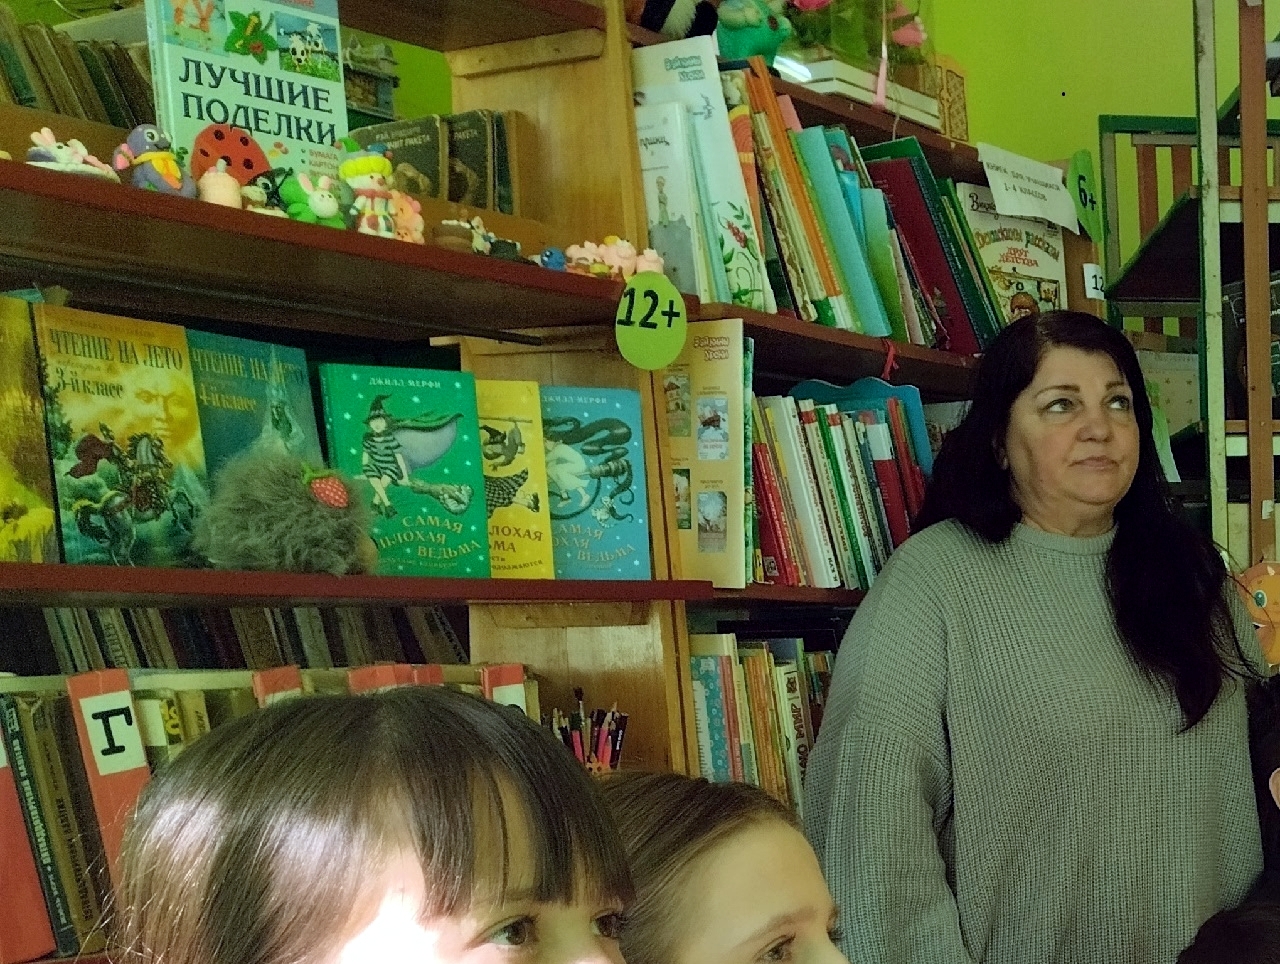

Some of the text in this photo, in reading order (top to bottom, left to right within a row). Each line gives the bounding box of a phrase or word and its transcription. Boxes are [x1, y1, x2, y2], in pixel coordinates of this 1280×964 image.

[178, 57, 333, 114] ЛУЧШИЕ
[181, 91, 336, 147] ПОДЕЛКИ
[1077, 174, 1097, 211] 6+
[616, 286, 681, 330] 12+
[50, 328, 114, 362] ЧТЕНИЕ
[118, 340, 139, 365] НА
[142, 343, 183, 370] ЛЕТО
[192, 348, 248, 379] ЧТЕНИЕ
[379, 529, 446, 551] ПЛОХАЯ
[402, 515, 463, 534] САМАЯ
[490, 524, 544, 542] ЛОХАЯ
[417, 540, 482, 561] ВЕДЬМА
[576, 544, 636, 562] ВЕДЬМА
[92, 704, 133, 757] Г
